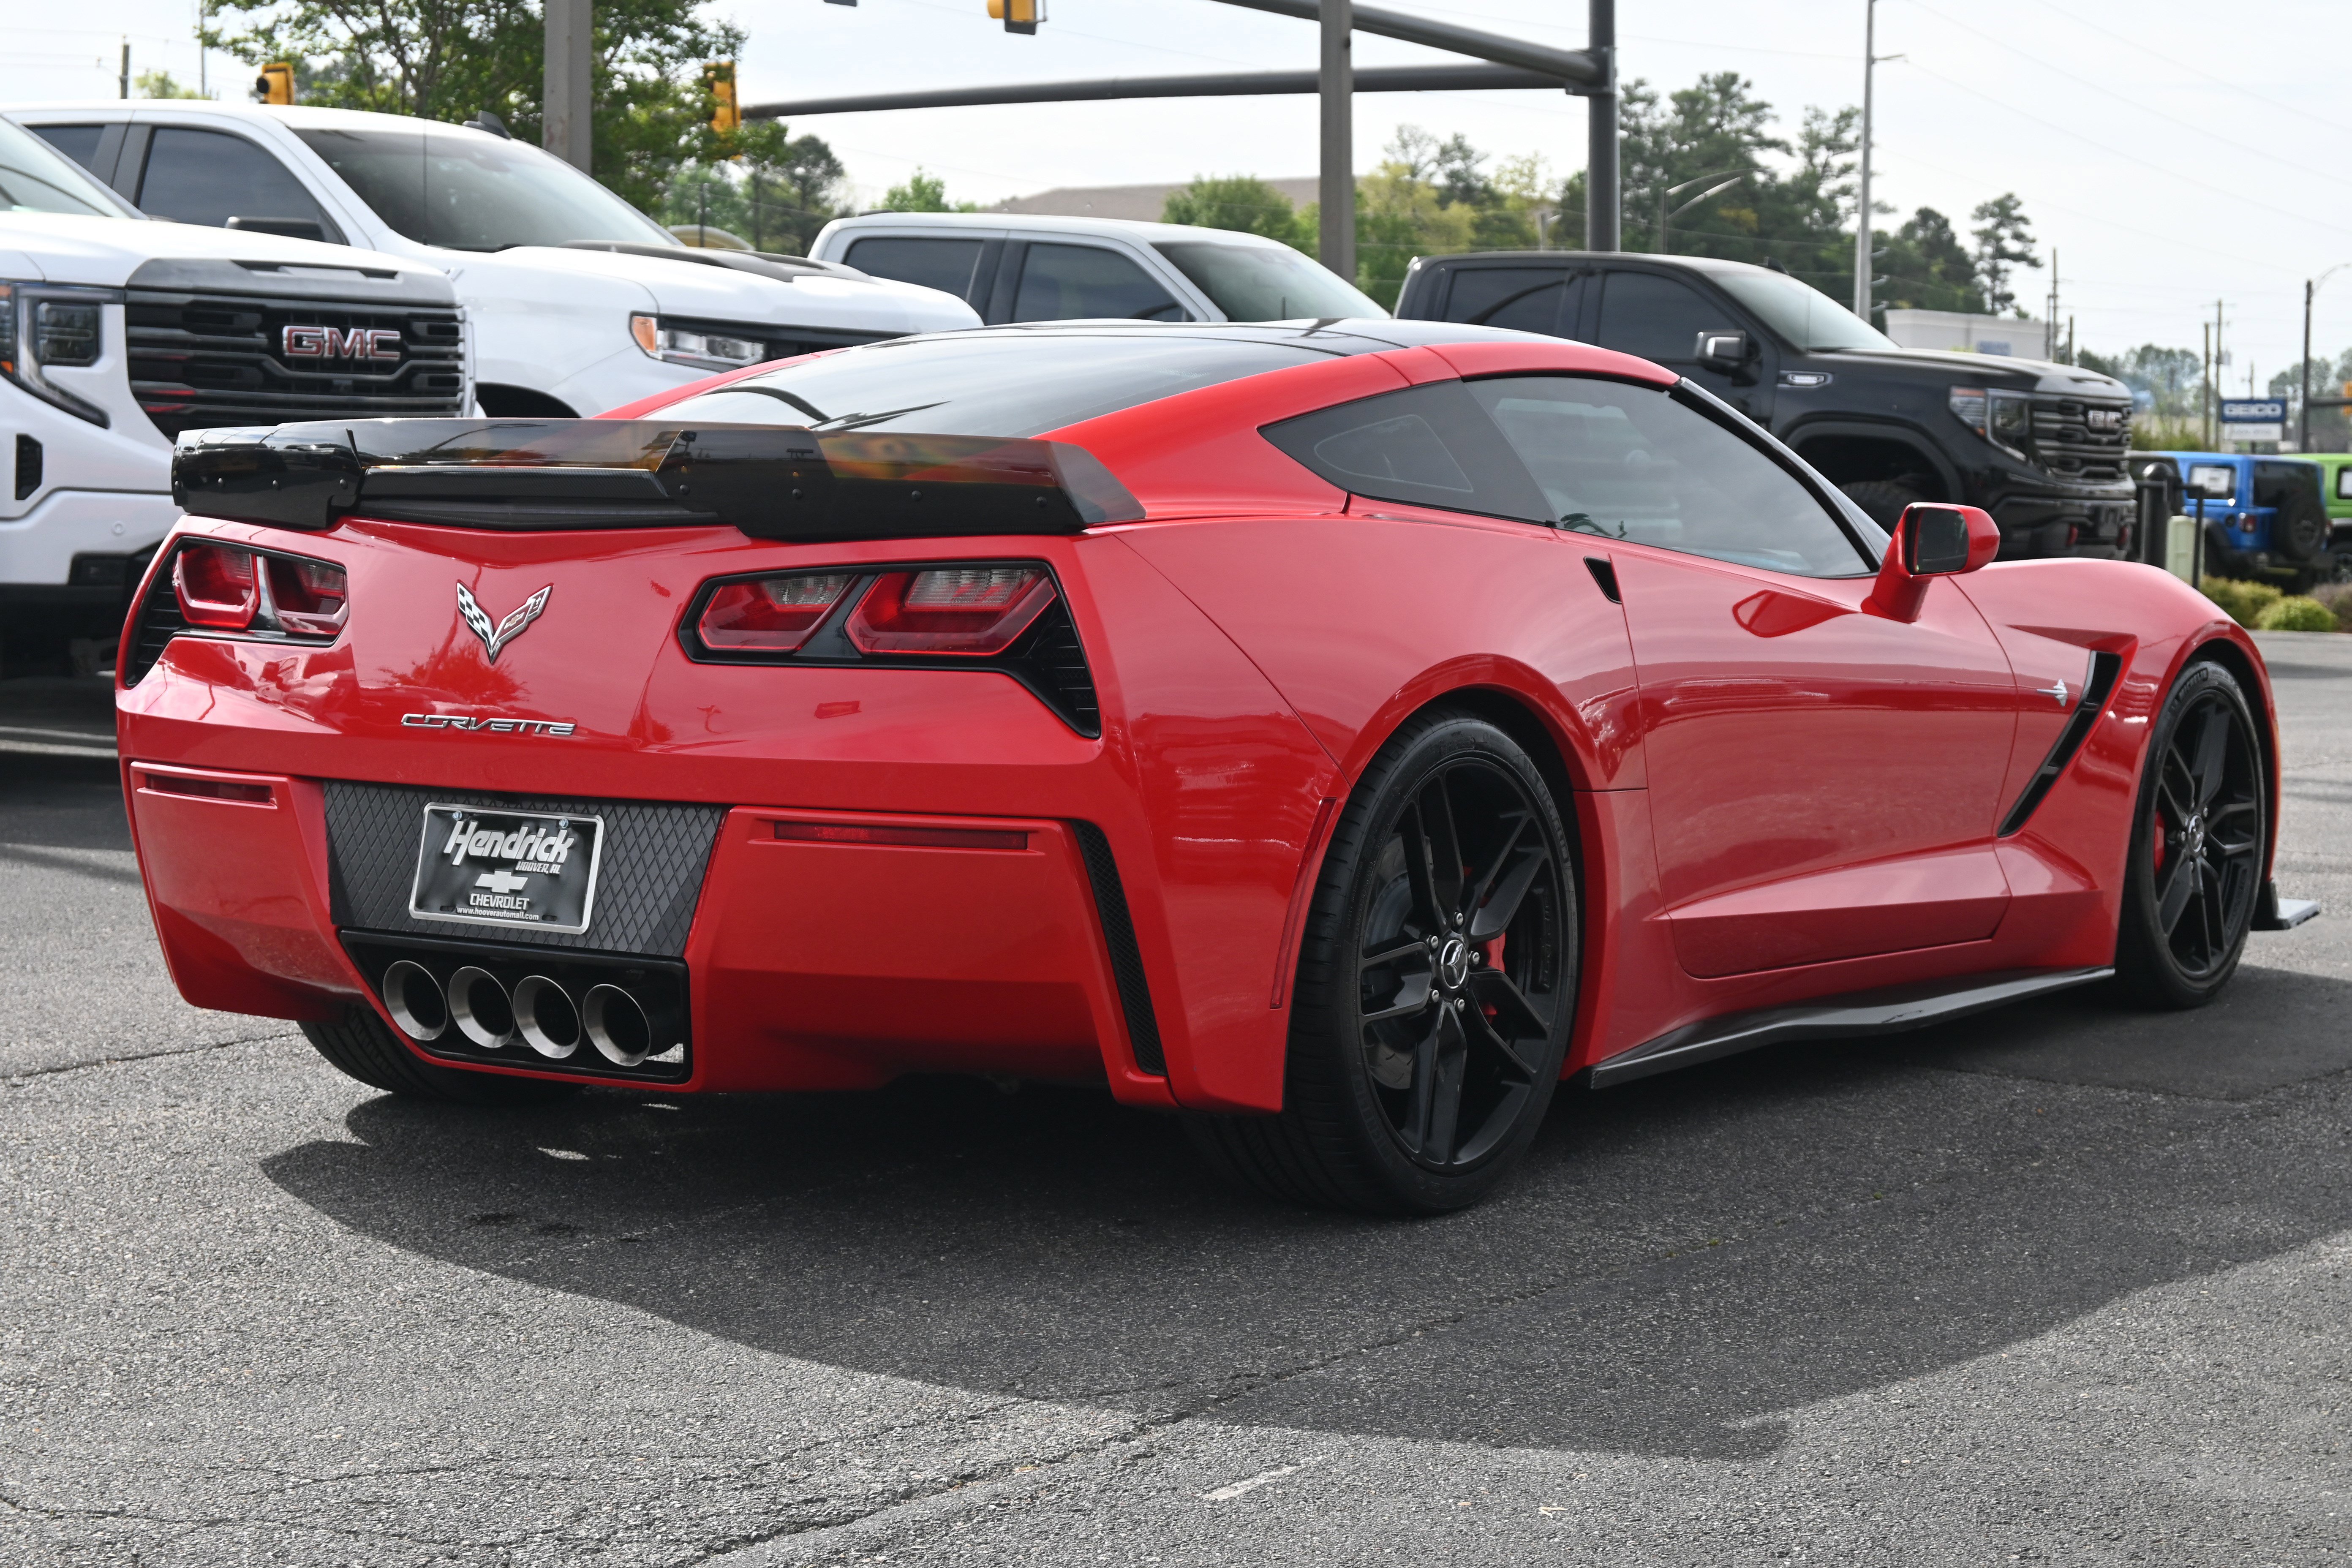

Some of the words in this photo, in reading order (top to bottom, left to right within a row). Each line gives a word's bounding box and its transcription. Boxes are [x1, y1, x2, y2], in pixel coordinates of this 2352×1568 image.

[283, 326, 401, 362] GMC
[2223, 403, 2282, 417] GEICO
[401, 713, 575, 736] CORVETTE
[444, 821, 574, 866] Hendrick
[515, 861, 549, 874] HOOVER,
[549, 864, 561, 874] AL
[470, 893, 530, 910] CHEVROLET
[457, 907, 539, 921] www.hooverautomall.com
